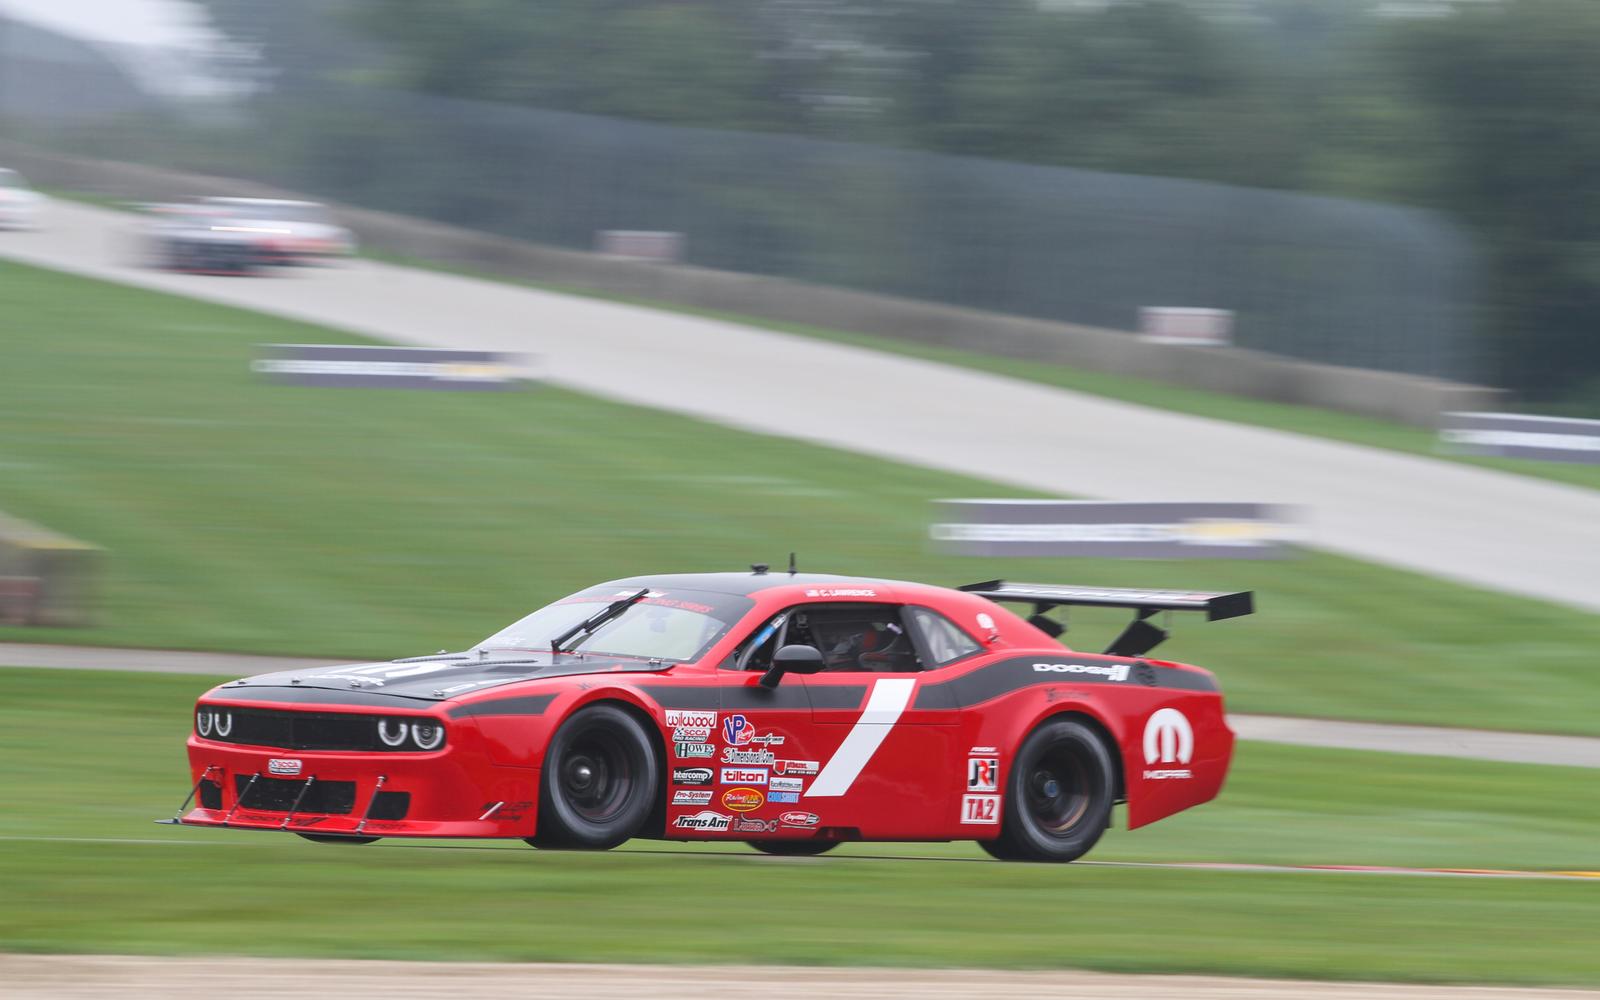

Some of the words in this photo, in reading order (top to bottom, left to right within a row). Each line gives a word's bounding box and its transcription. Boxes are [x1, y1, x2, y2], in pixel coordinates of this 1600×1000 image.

[667, 711, 717, 728] wilwood
[723, 715, 746, 745] VP
[277, 760, 300, 769] SCCA
[674, 769, 708, 781] Intercomp
[724, 770, 765, 782] tilton
[676, 791, 711, 799] Pro-System
[967, 799, 995, 820] TA2
[677, 816, 708, 827] Trans
[708, 816, 729, 827] Am
